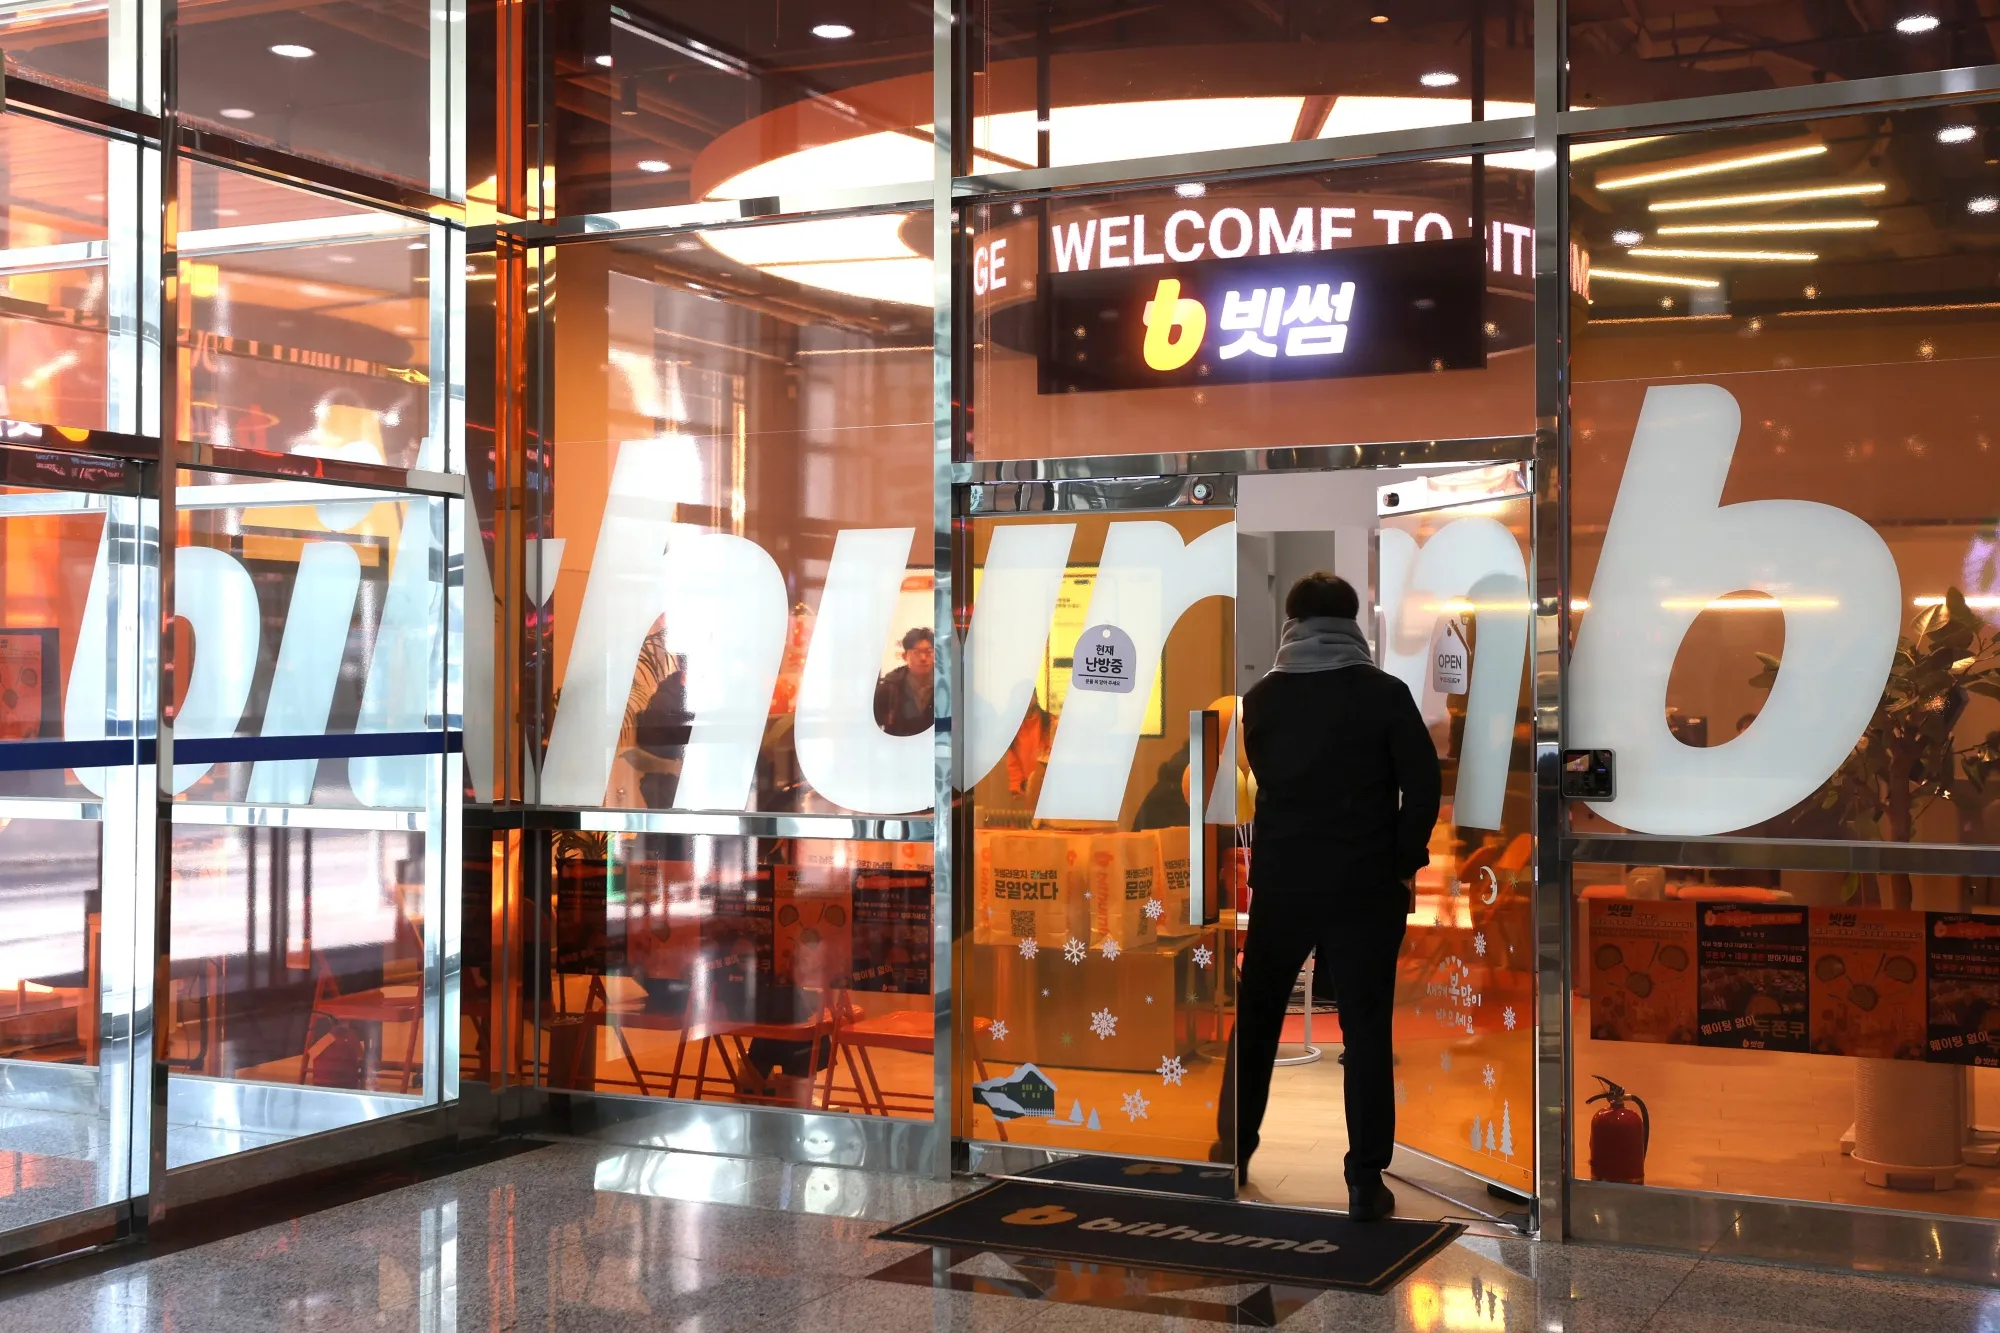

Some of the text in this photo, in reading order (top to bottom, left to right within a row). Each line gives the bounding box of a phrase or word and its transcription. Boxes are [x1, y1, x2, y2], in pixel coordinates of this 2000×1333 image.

[1051, 206, 1356, 273] WELCOME
[1373, 208, 1453, 242] TO
[1219, 281, 1356, 361] 빗썸
[1096, 645, 1114, 656] 현재
[1086, 657, 1123, 674] 난방중
[1438, 654, 1462, 670] OPEN
[1030, 869, 1058, 880] 강남점
[994, 879, 1059, 900] 문열었다
[1828, 912, 1857, 927] 빗썸
[1461, 984, 1482, 1008] 많이
[1700, 1015, 1755, 1036] 웨이팅 없이
[1930, 1034, 1964, 1052] 웨이팅
[1967, 1030, 1990, 1045] 없이
[1077, 1217, 1340, 1255] bithumb
